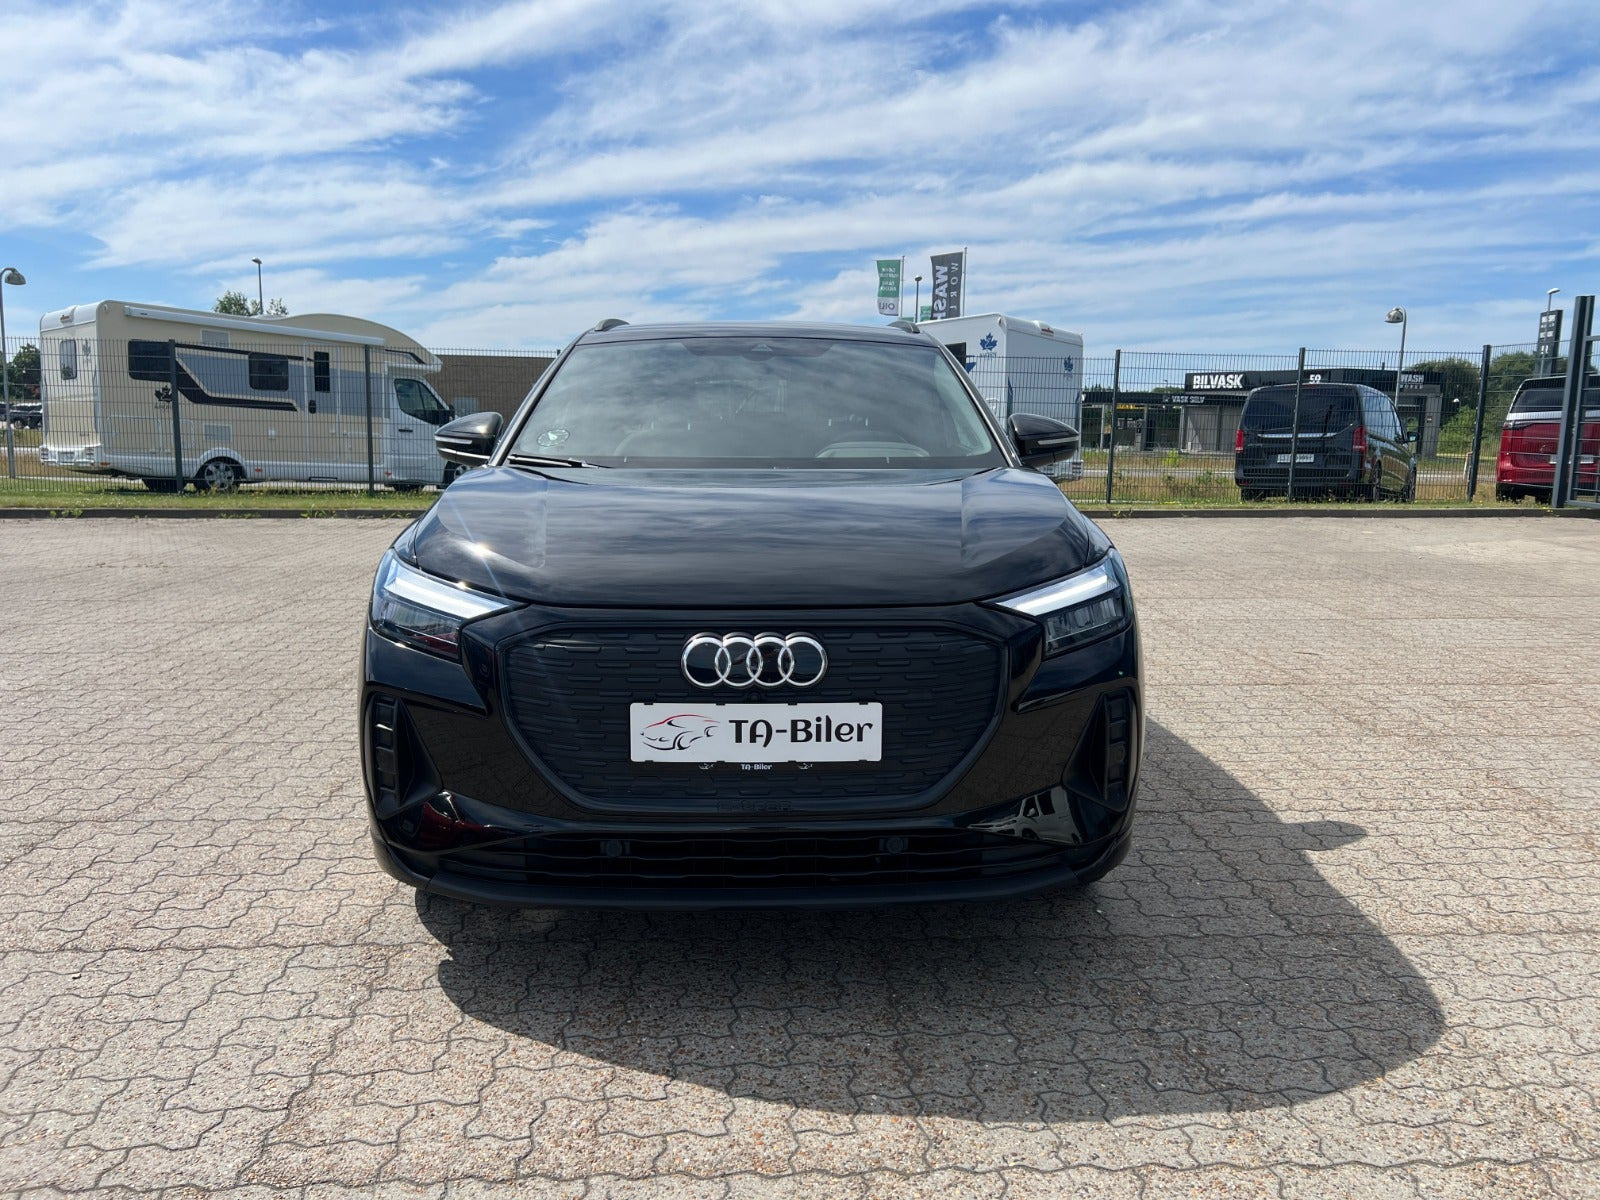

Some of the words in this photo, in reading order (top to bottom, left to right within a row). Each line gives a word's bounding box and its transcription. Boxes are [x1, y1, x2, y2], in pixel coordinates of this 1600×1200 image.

[1193, 374, 1243, 389] BILVASK
[1309, 374, 1321, 384] 59
[729, 714, 874, 748] TA-Biler
[741, 763, 772, 771] TA-Biler
